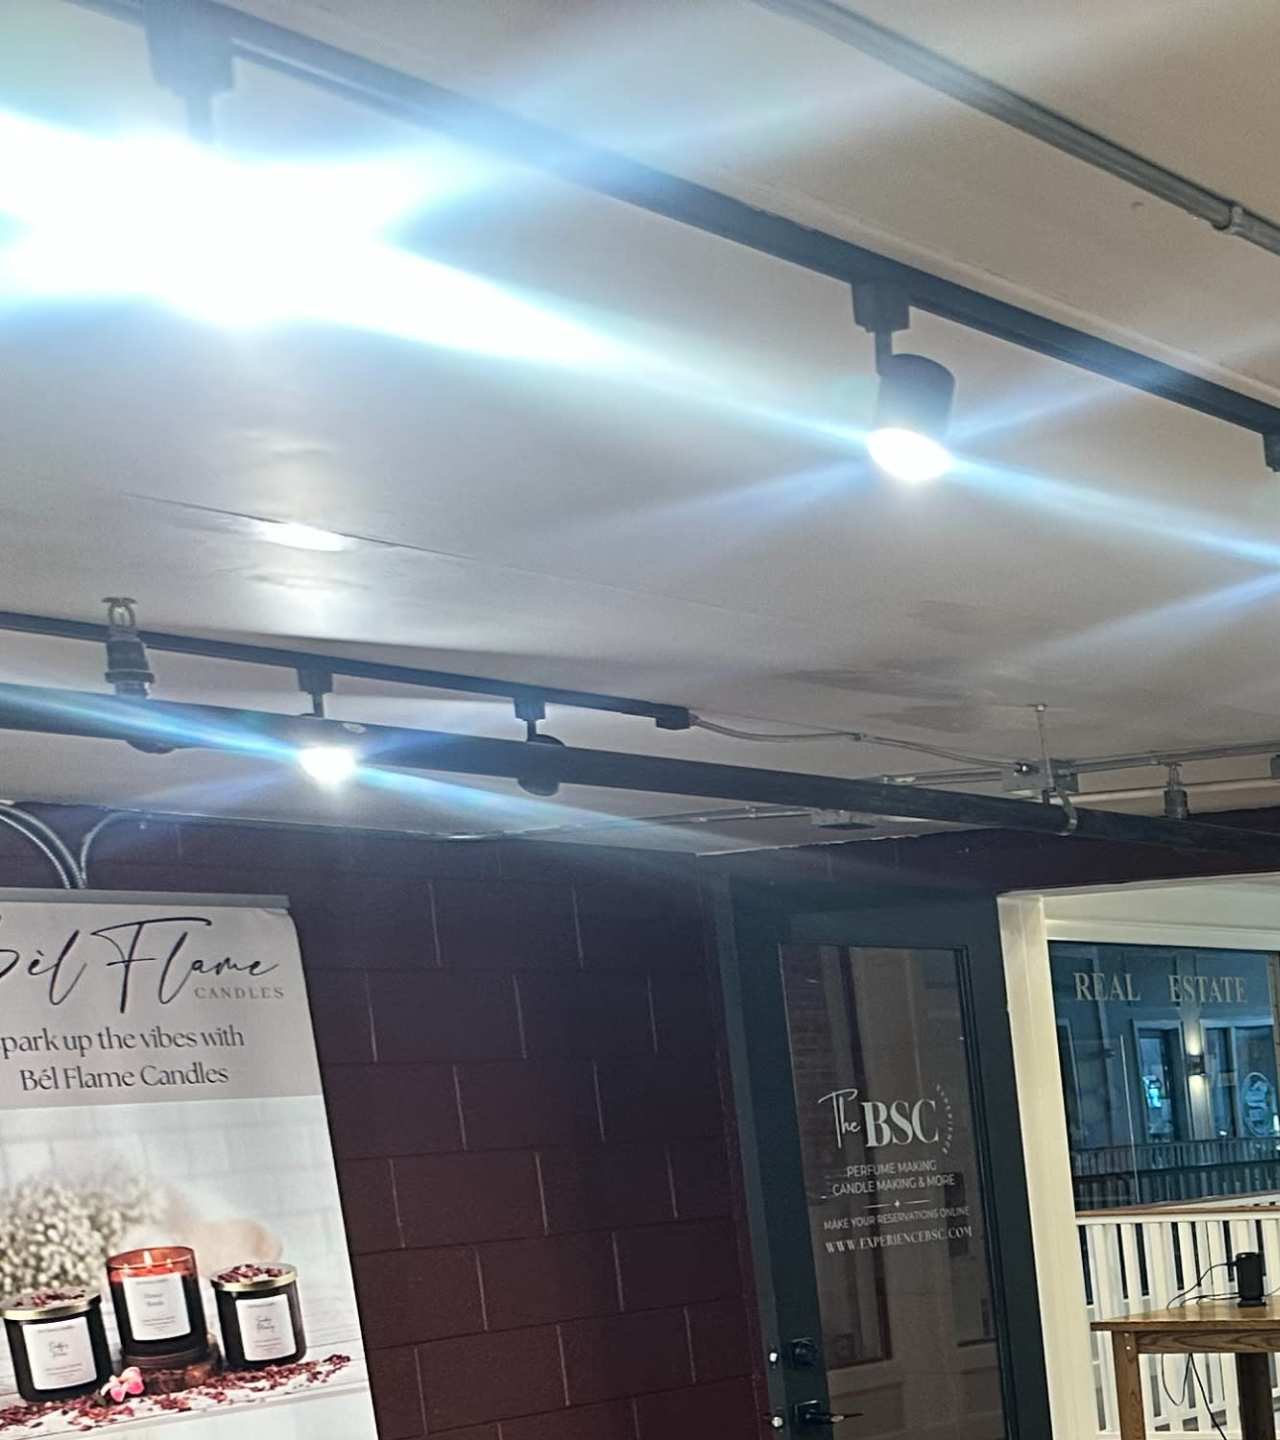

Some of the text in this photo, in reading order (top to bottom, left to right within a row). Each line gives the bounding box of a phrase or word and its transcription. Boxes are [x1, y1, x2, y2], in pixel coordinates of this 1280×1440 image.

[91, 916, 281, 1014] Flame
[194, 986, 285, 1000] CANDLES
[1073, 972, 1248, 1004] REAL ESTATE
[0, 1024, 245, 1060] park up the vibes with
[63, 1065, 135, 1090] Flame
[140, 1061, 230, 1087] Candles
[818, 1088, 939, 1149] The BSC
[846, 1159, 937, 1178] PERFUME MAKING
[832, 1181, 876, 1196] CANDLE
[877, 1177, 917, 1191] MAKING
[927, 1174, 955, 1187] MORE
[824, 1206, 970, 1231] MAKE YOUR RESERVATIONS ONLINE
[825, 1225, 973, 1254] WWW.EXPERIENCEBSC.COM
